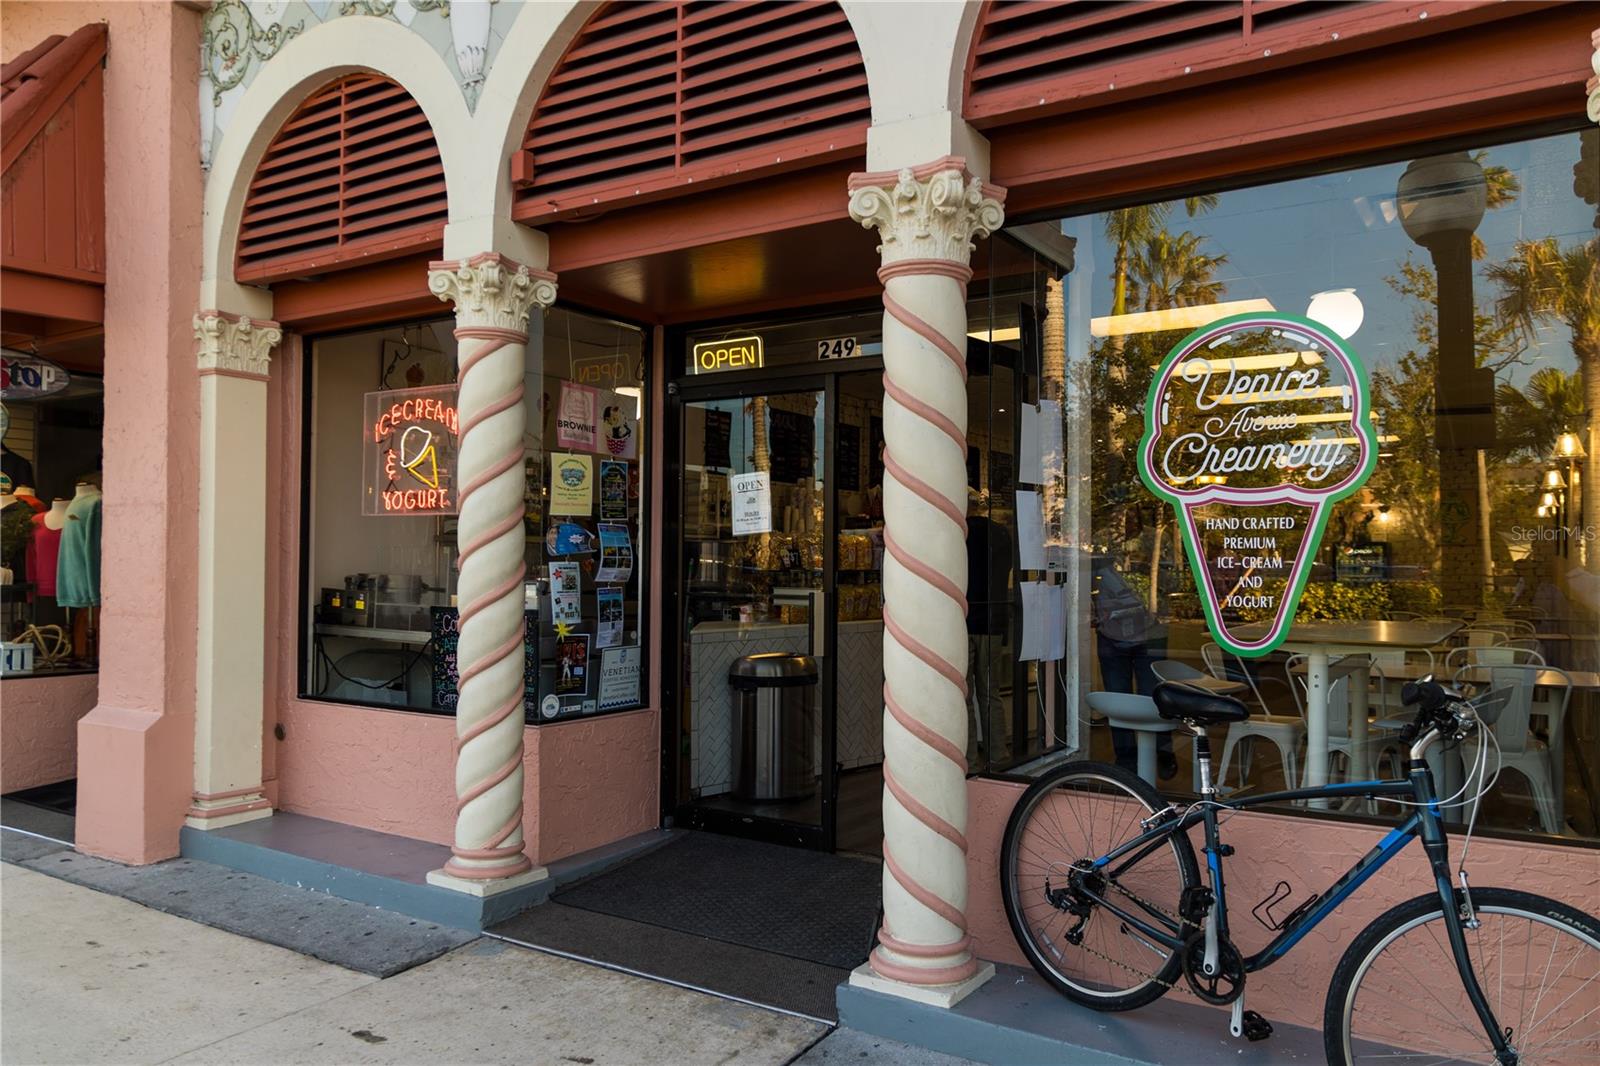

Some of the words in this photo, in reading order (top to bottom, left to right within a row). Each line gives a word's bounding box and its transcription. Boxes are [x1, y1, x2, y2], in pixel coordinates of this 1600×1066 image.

[818, 338, 855, 360] 249
[700, 345, 755, 370] OPEN
[1181, 357, 1321, 410] Venice
[557, 419, 598, 434] BROWNIE
[1204, 406, 1298, 439] Avenue
[1163, 432, 1347, 482] Creamery
[737, 479, 764, 491] OPEN
[382, 487, 448, 511] YOGURT
[1206, 517, 1239, 530] HAND
[1242, 517, 1295, 530] CRAFTED
[1223, 537, 1276, 549] PREMIUM
[1217, 556, 1283, 569] ICE-CREAM
[1238, 576, 1263, 588] AND
[1226, 595, 1275, 608] YOGURT
